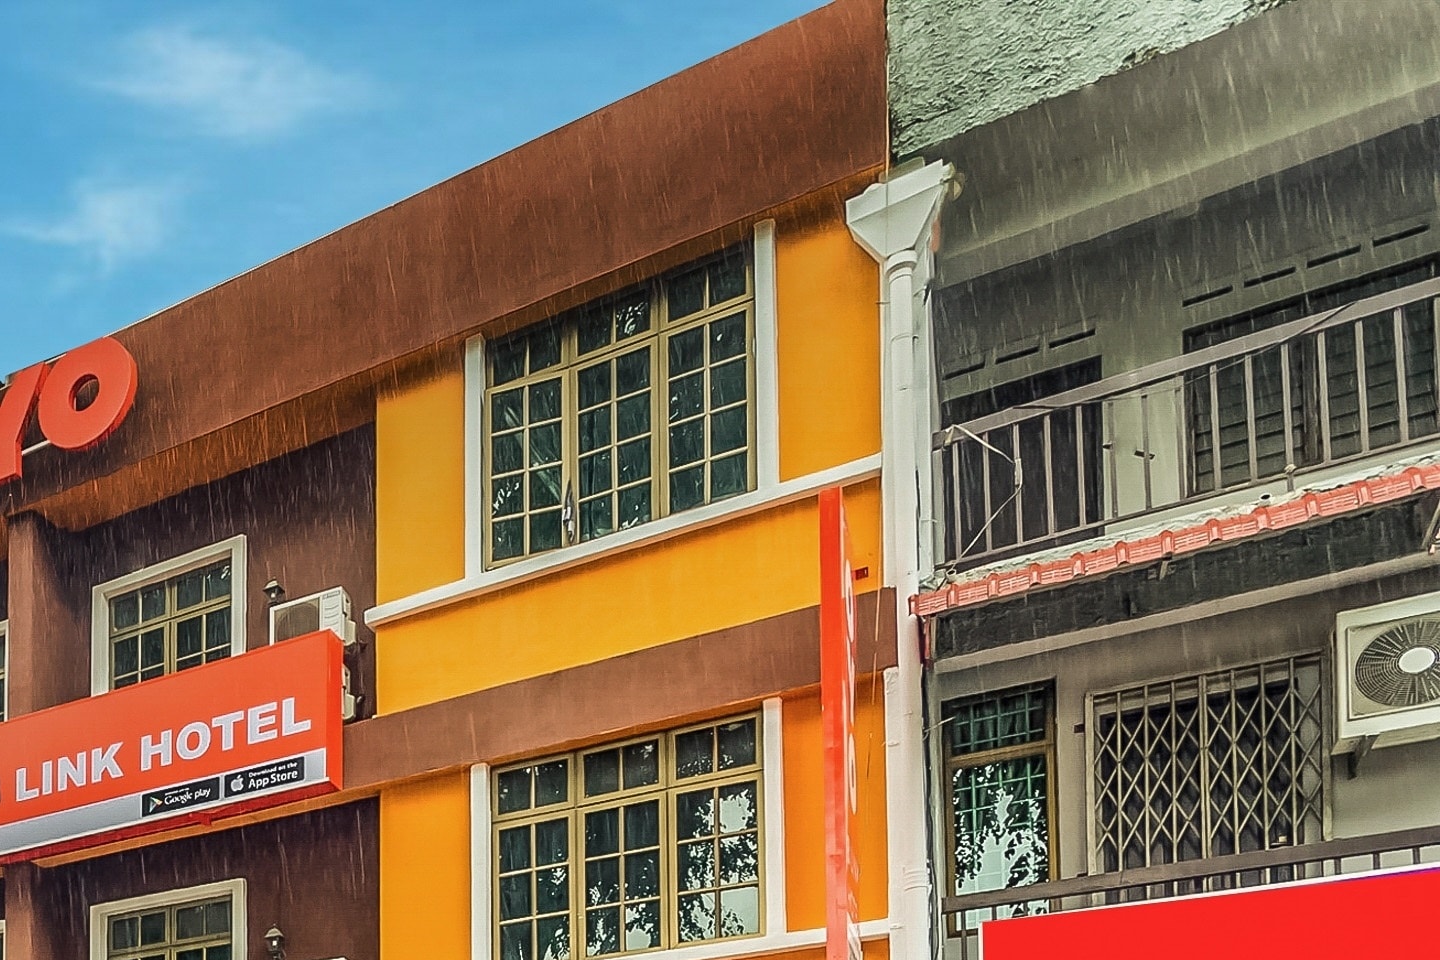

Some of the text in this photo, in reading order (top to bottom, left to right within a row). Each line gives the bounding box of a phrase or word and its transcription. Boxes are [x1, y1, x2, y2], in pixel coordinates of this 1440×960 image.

[15, 741, 125, 802] LINK
[140, 697, 312, 772] HOTEL
[248, 770, 298, 789] App Store
[164, 790, 193, 805] Google
[194, 788, 211, 800] play
